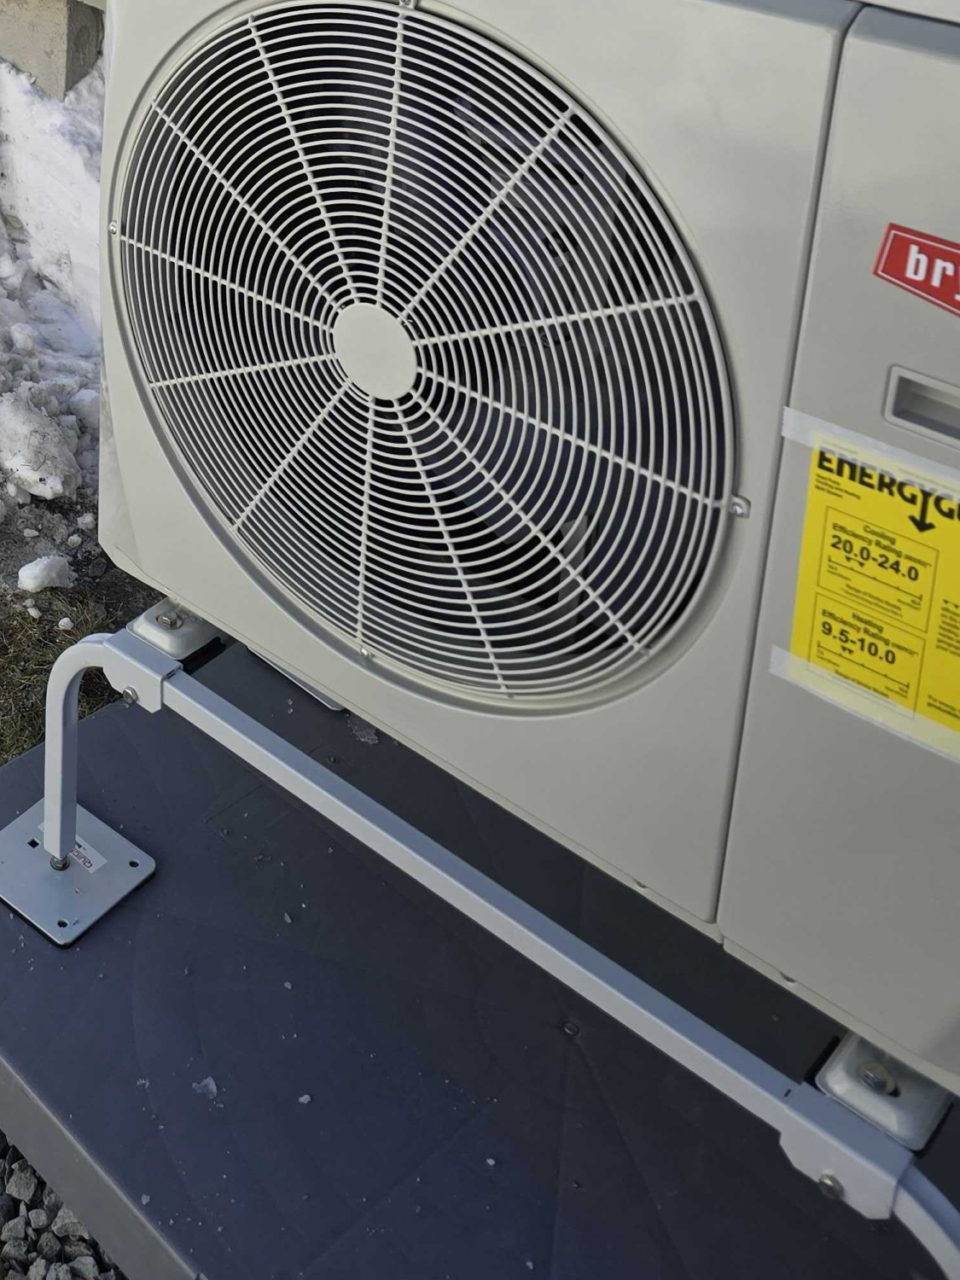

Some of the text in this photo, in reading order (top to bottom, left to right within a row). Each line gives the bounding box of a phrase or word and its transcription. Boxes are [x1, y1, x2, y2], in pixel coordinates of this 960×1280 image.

[905, 244, 960, 301] br
[832, 522, 903, 558] Efficiency Rating
[863, 525, 896, 546] Cooling
[830, 535, 919, 582] 20.0-24.0
[822, 608, 890, 646] Efficiency Rating
[852, 612, 884, 633] Heating
[821, 621, 896, 664] 9.5-10.0
